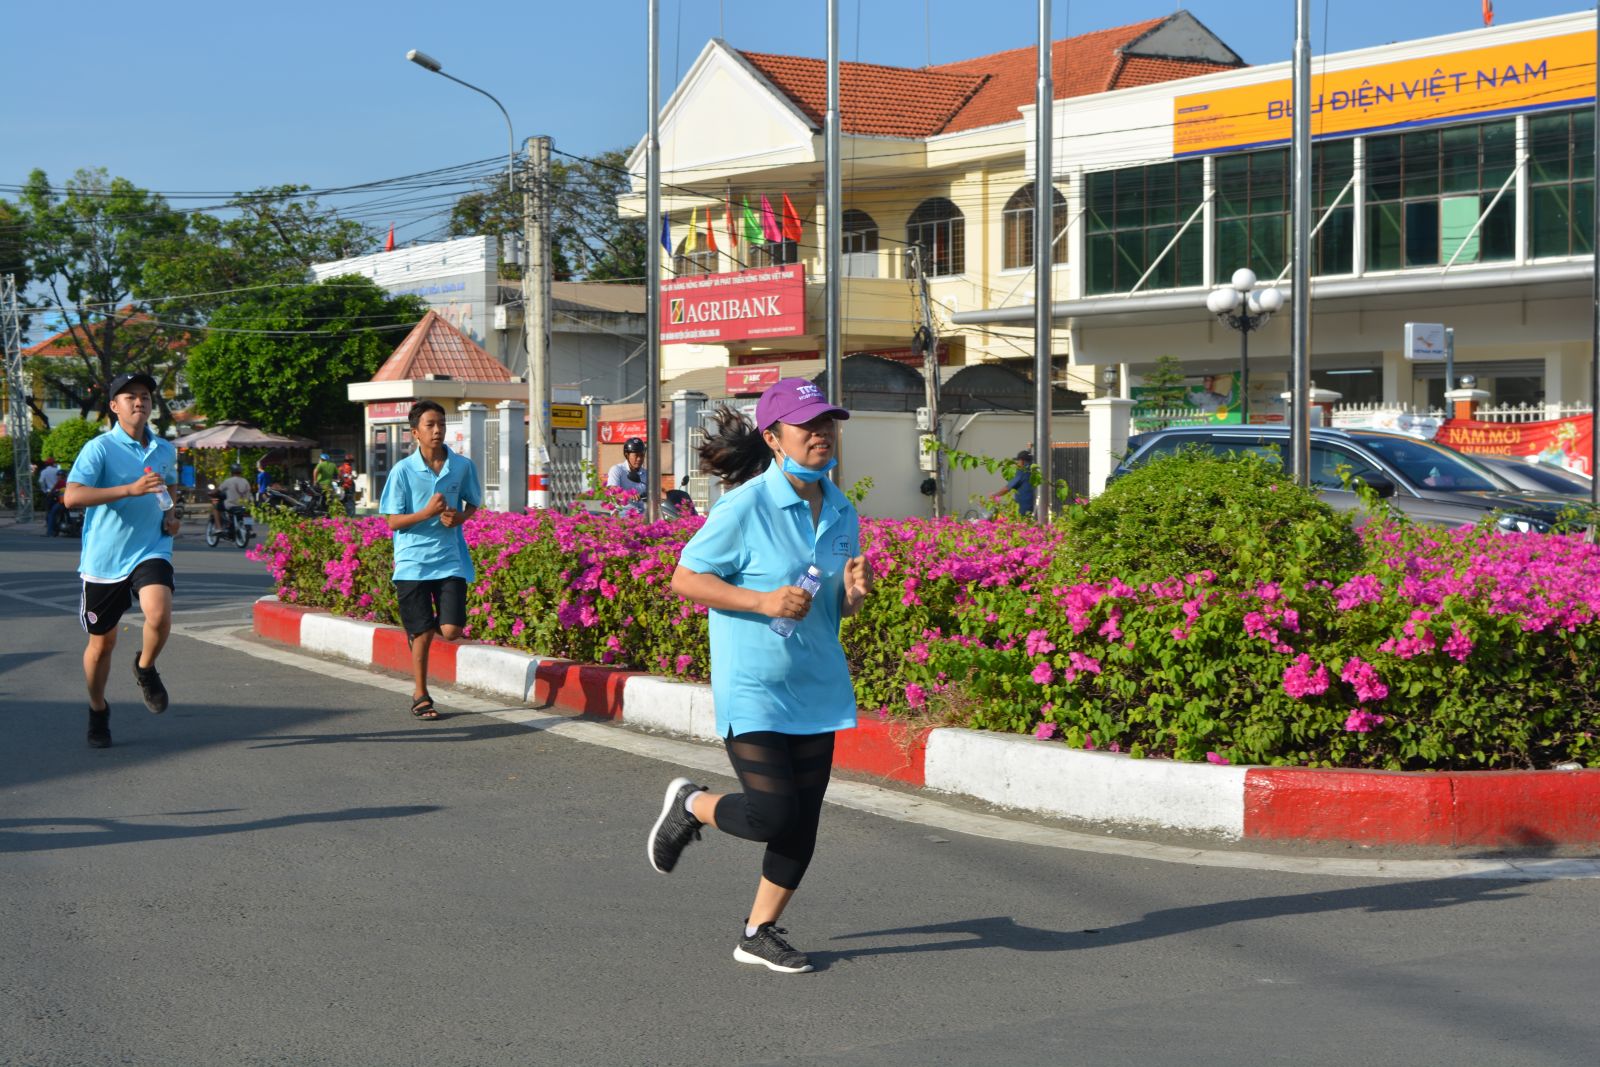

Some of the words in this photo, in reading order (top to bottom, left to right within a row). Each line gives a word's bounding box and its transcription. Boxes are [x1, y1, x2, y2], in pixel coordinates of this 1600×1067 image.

[1331, 79, 1395, 113] ĐIỆN
[1401, 68, 1467, 103] VIỆT
[1476, 60, 1548, 90] NAM
[686, 295, 783, 323] AGRIBANK
[1474, 445, 1512, 456] KHANG
